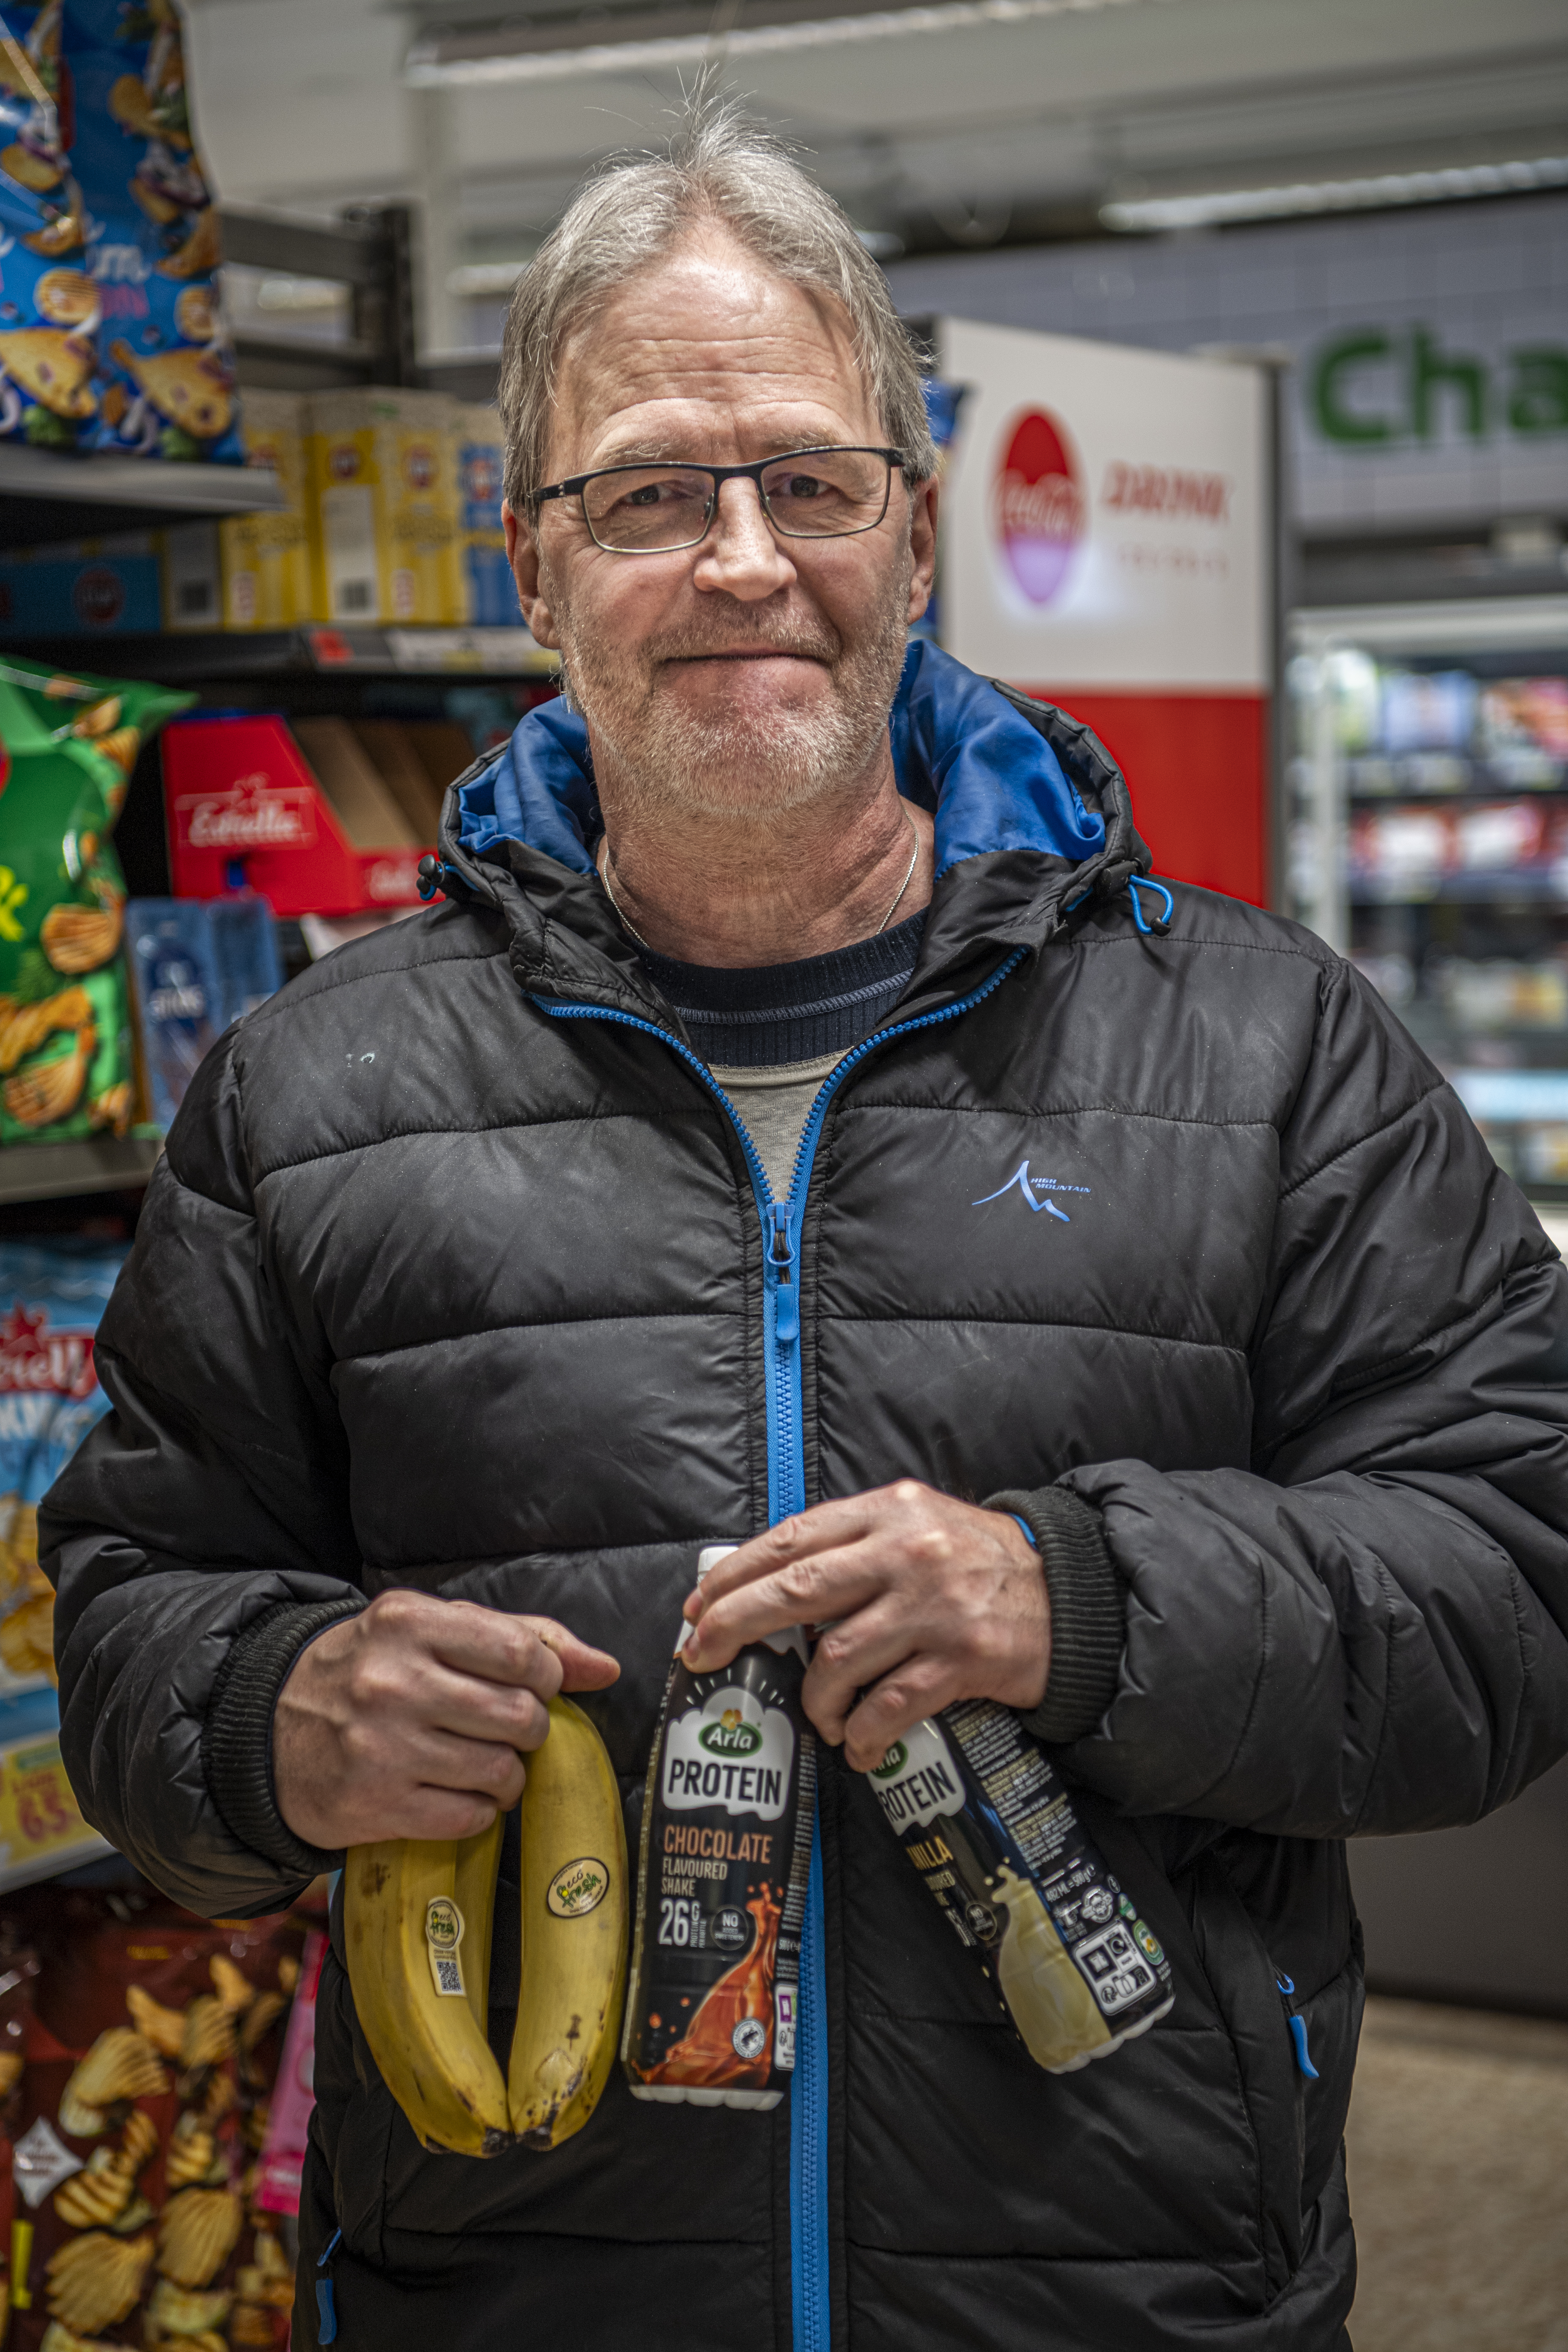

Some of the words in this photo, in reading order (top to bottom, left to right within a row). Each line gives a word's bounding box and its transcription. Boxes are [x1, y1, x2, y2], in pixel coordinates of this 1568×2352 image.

[1036, 1183, 1091, 1193] MOUNTAIN
[707, 1726, 753, 1750] Arla
[668, 1759, 782, 1806] PROTEIN
[664, 1824, 773, 1864] CHOCOLATE
[567, 1871, 583, 1888] eco
[663, 1856, 728, 1880] FLAVOURED
[557, 1873, 601, 1908] fresh
[661, 1877, 696, 1897] SHAKE
[658, 1899, 689, 1946] 26
[722, 1914, 738, 1927] NO
